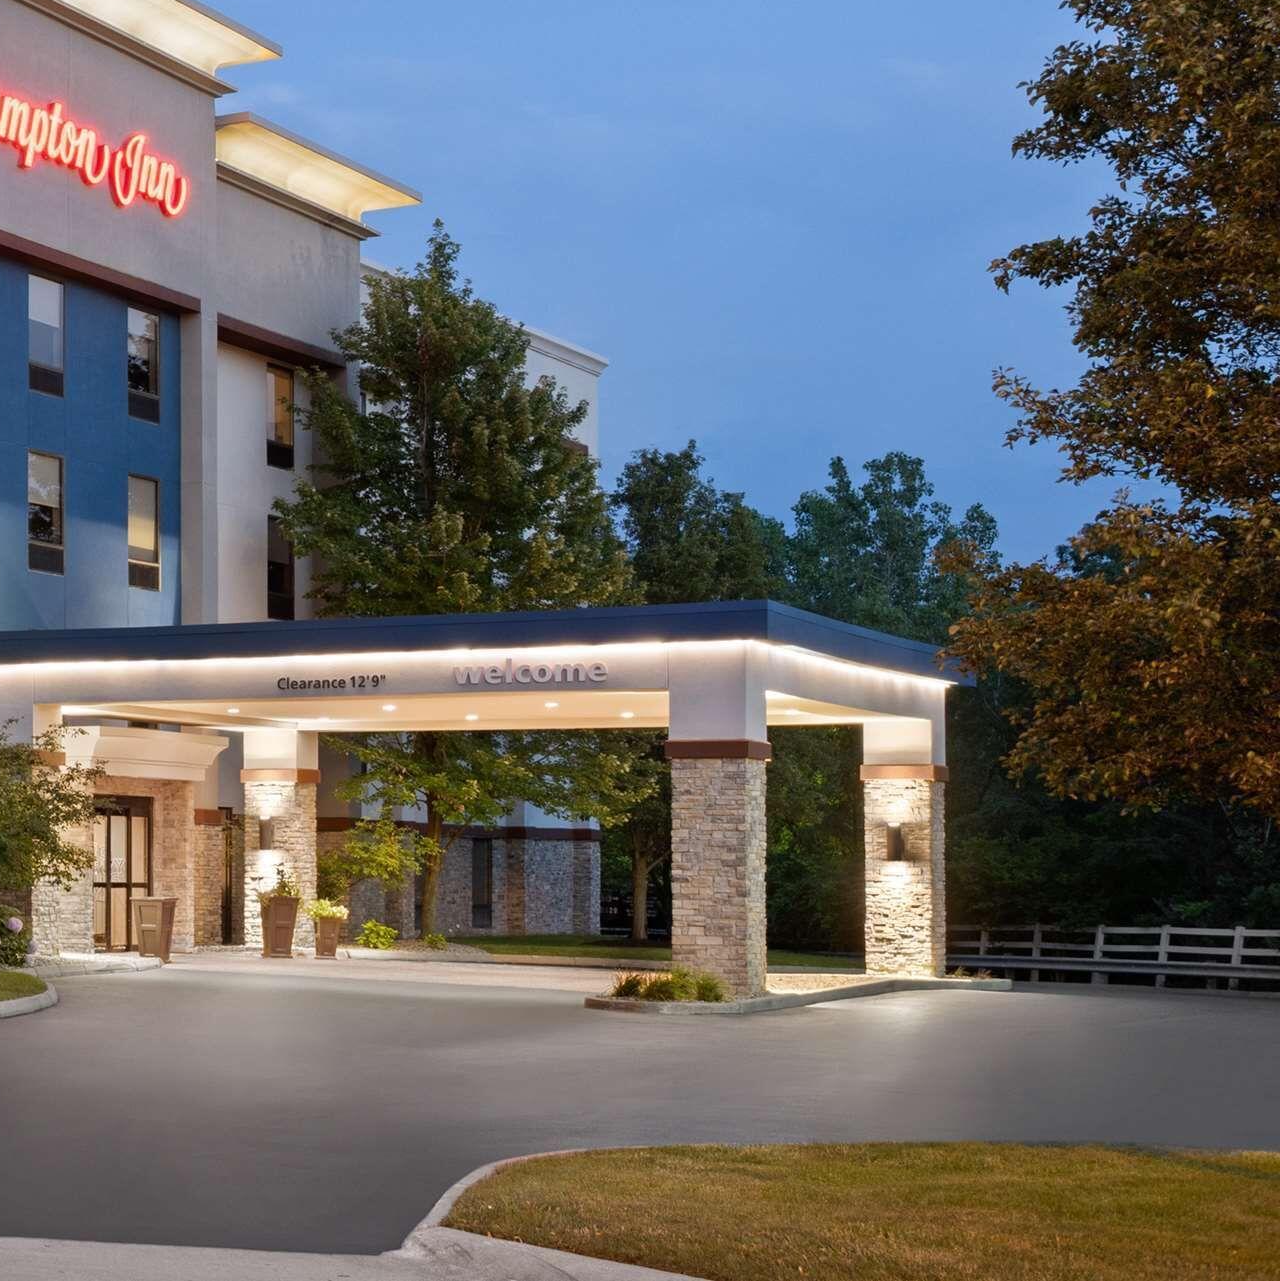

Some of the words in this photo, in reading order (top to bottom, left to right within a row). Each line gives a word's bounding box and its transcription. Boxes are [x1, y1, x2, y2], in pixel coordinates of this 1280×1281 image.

[110, 134, 187, 216] Inn
[277, 677, 346, 690] Clearance
[452, 658, 608, 685] welcome
